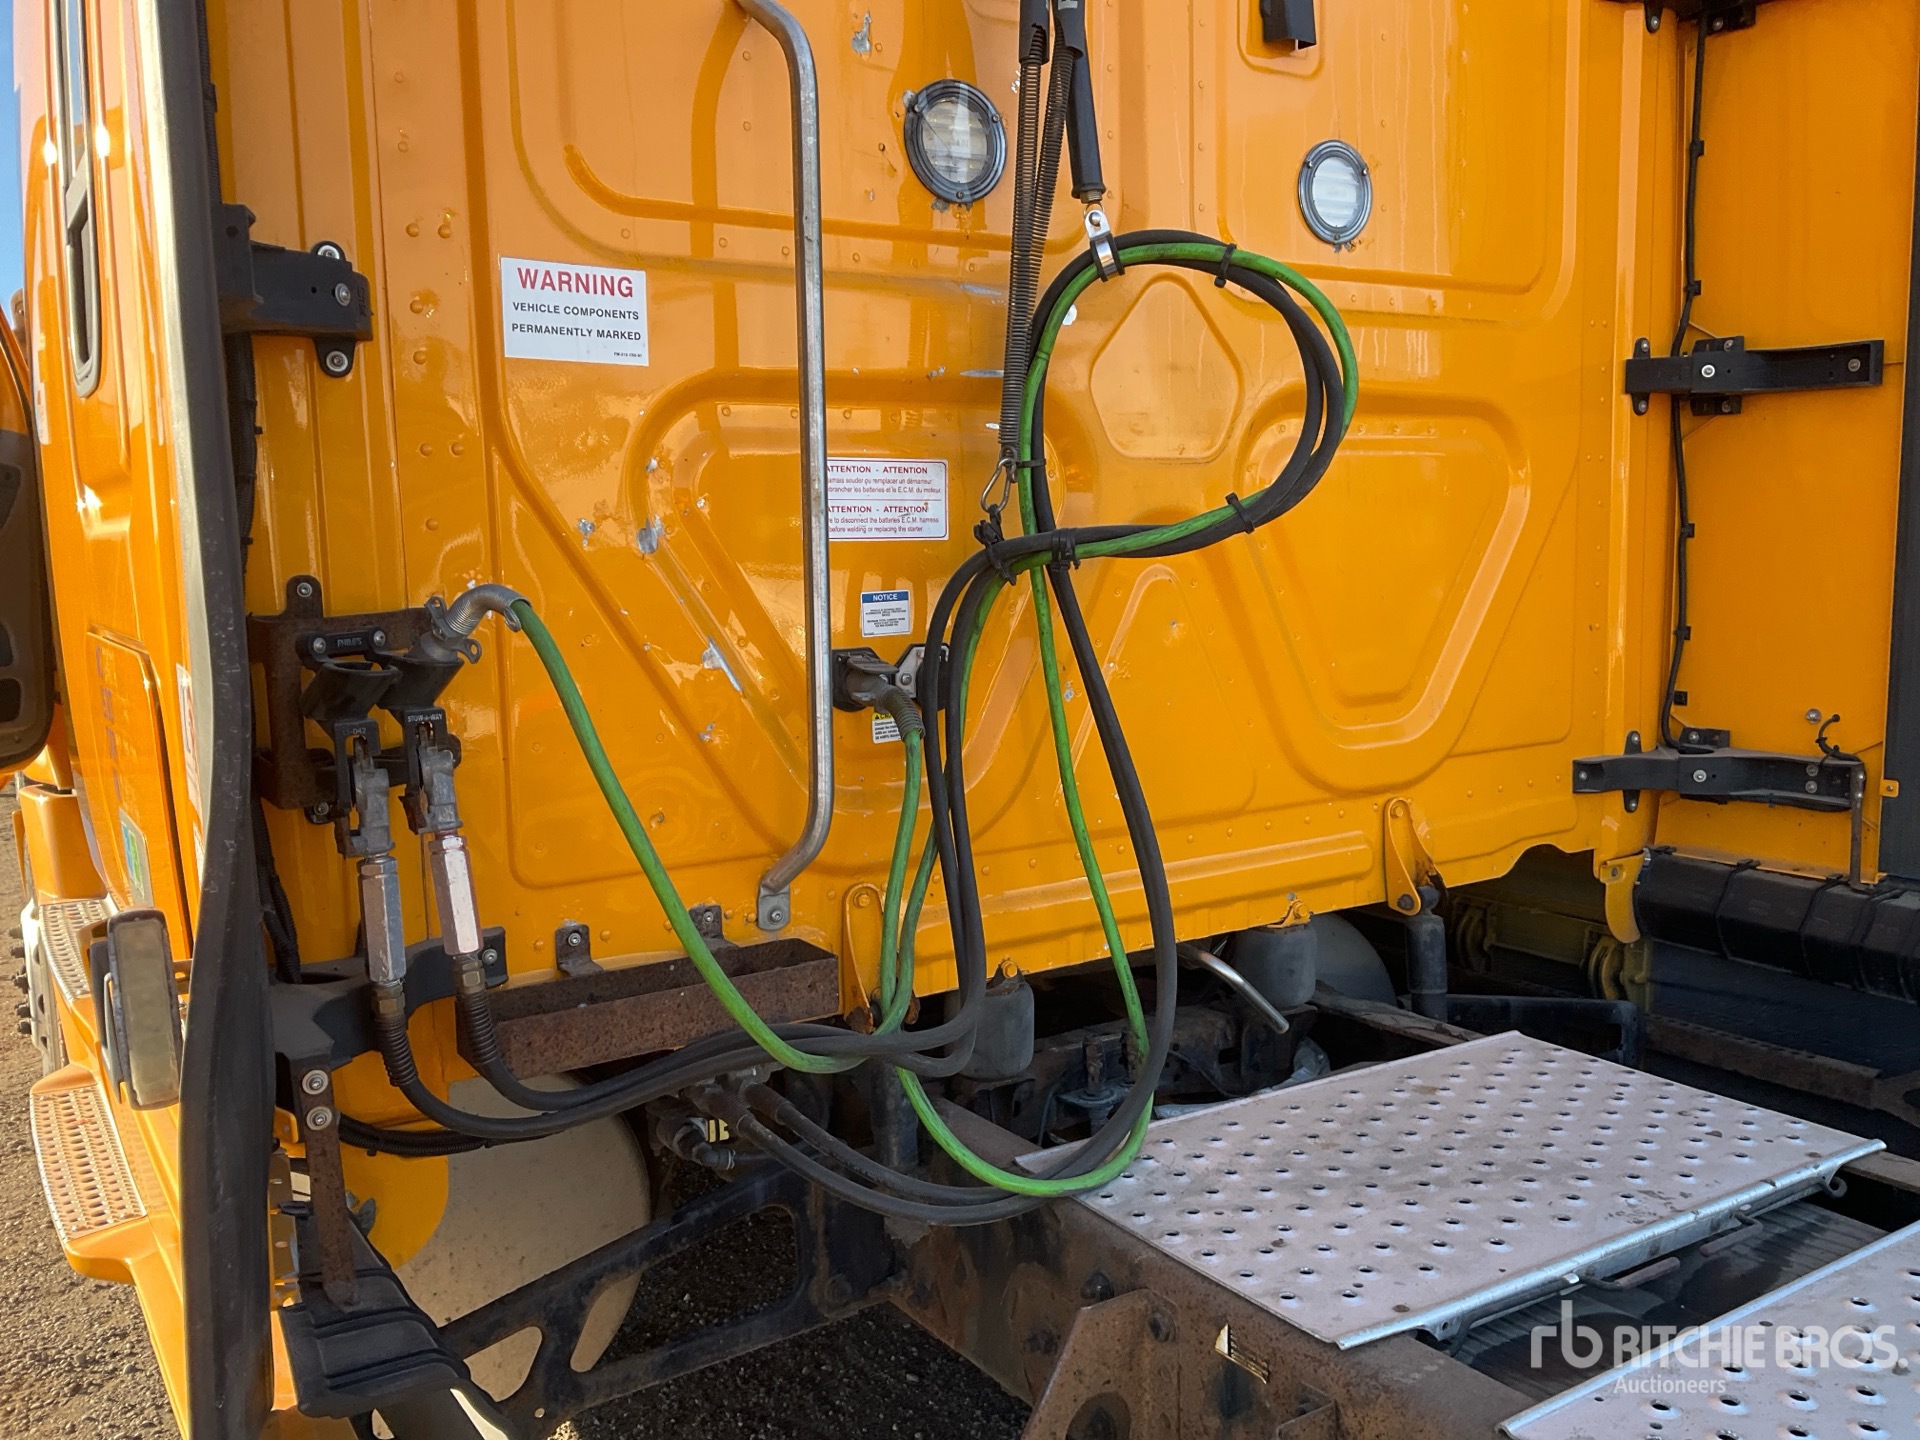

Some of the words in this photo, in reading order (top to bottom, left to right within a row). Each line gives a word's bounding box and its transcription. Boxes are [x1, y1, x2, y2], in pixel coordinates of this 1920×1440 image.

[517, 267, 633, 298] WARNING
[513, 302, 560, 314] VEHICLE
[563, 306, 639, 320] COMPONENTS
[512, 323, 593, 337] PERMANENTLY
[596, 329, 641, 341] MARKED
[827, 465, 871, 473] ATTENTION
[883, 466, 928, 474] ATTENTION
